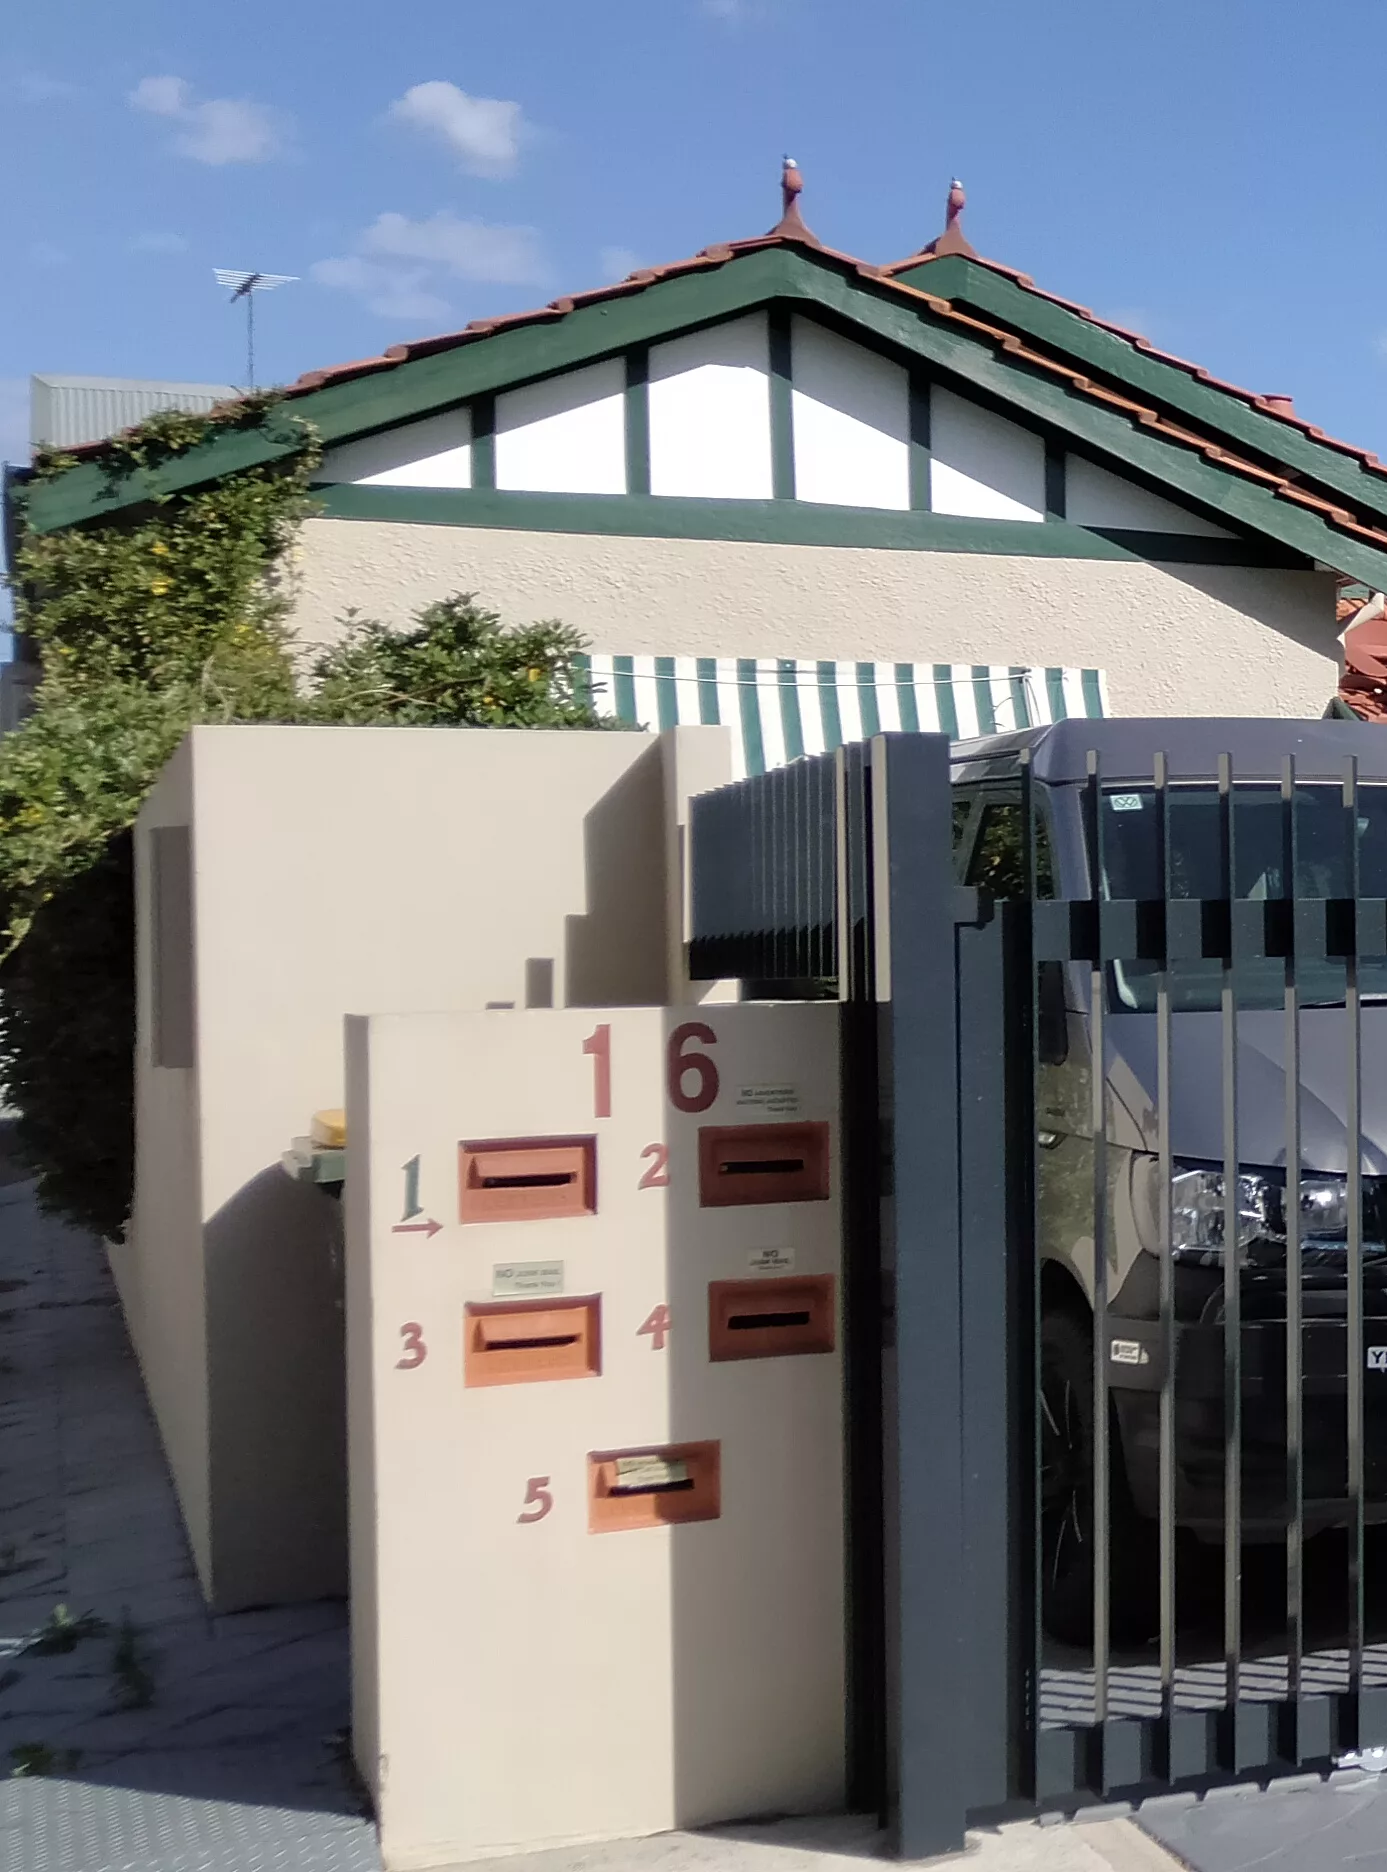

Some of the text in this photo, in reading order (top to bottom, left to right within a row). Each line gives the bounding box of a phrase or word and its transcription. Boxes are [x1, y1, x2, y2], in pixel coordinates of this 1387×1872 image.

[400, 1153, 425, 1222] 1
[637, 1142, 671, 1190] 2
[395, 1322, 428, 1370] 3
[636, 1303, 673, 1351] 4
[516, 1475, 554, 1524] 5
